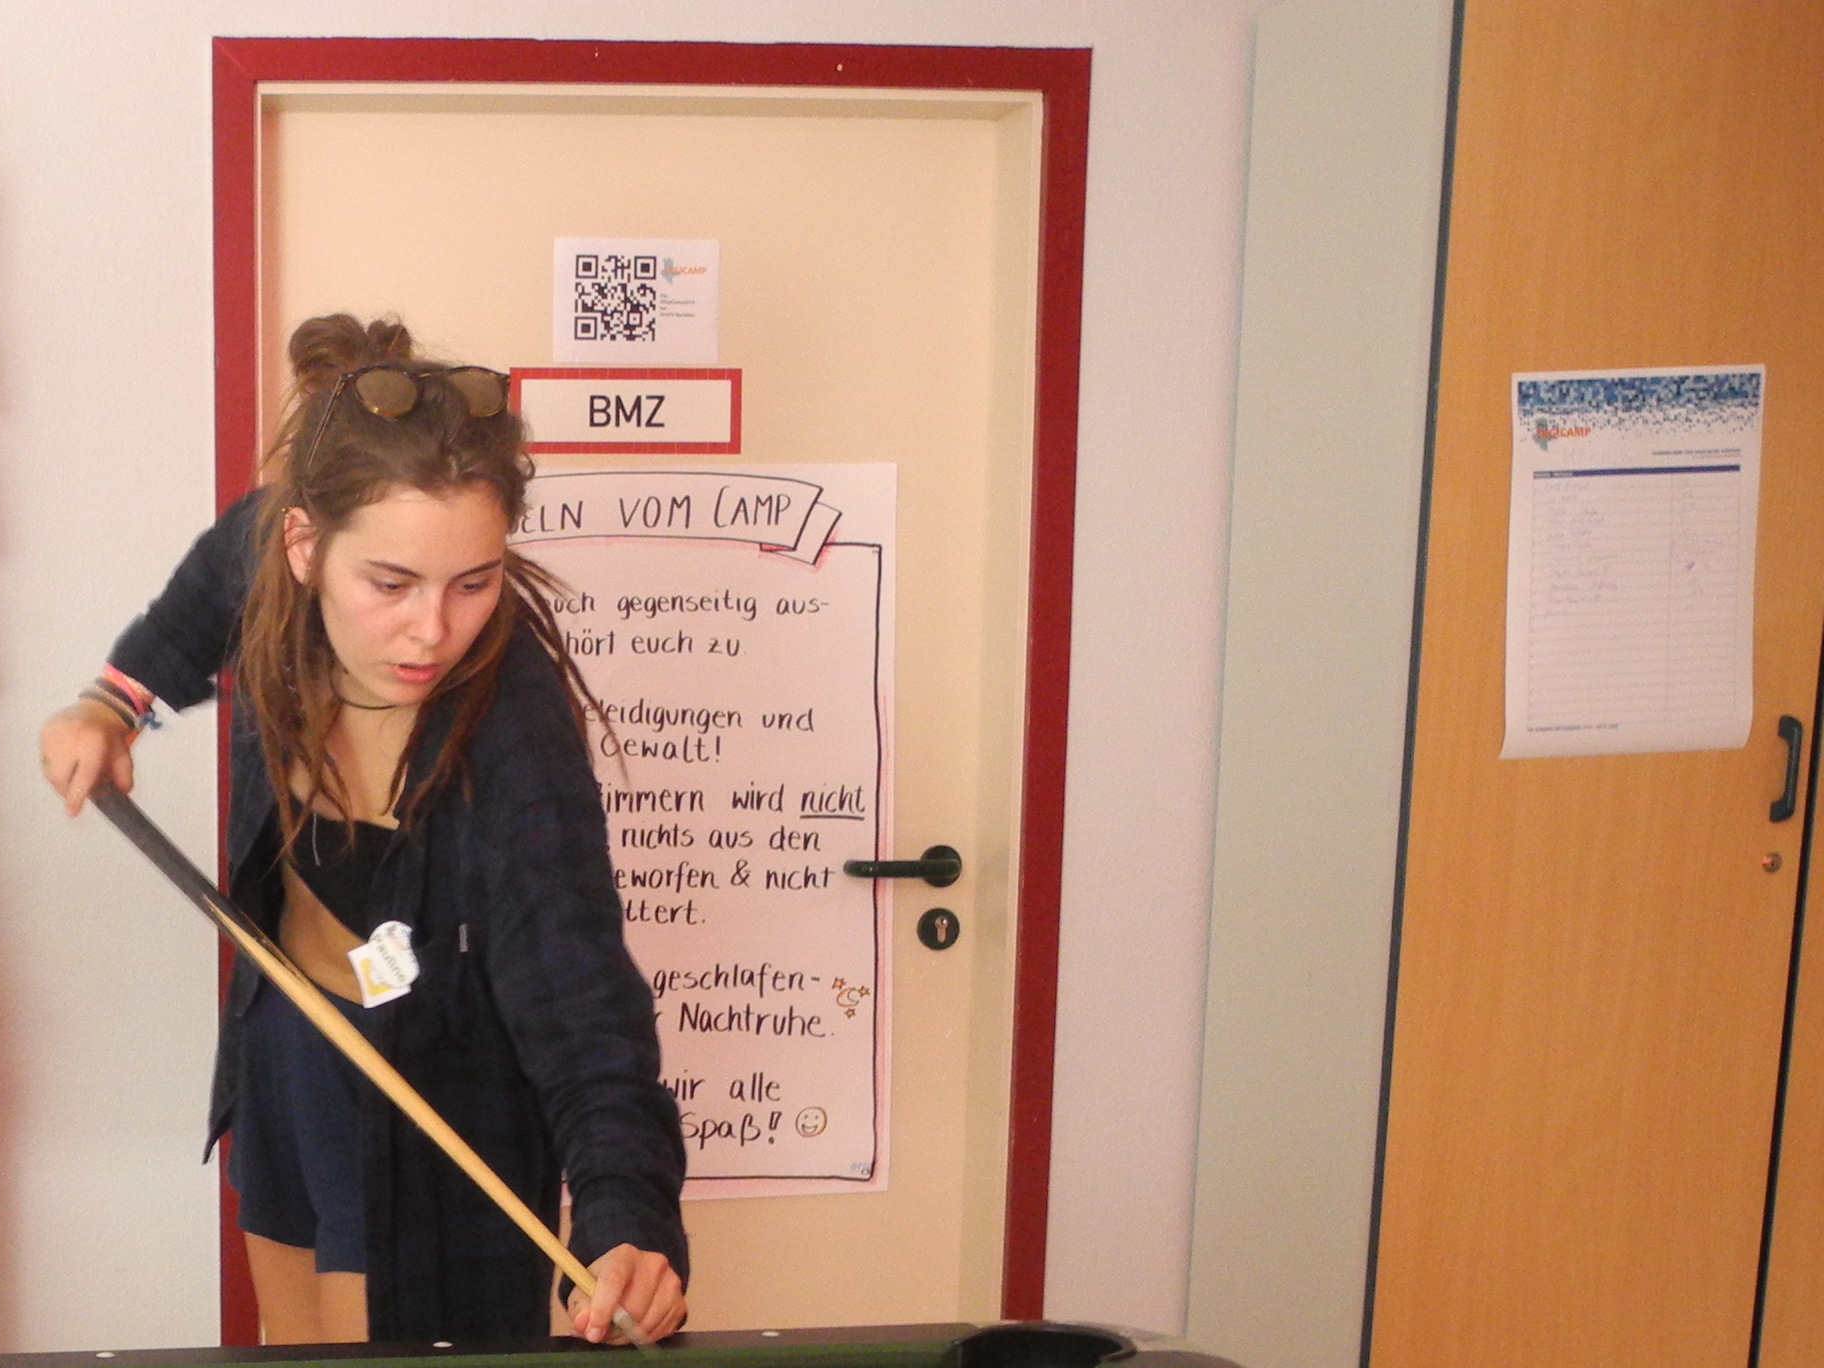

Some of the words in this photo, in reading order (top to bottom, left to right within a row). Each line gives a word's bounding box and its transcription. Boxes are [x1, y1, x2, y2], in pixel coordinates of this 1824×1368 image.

[588, 395, 666, 428] BMZ
[1537, 427, 1592, 439] DIGICAMP
[619, 494, 692, 530] VOM
[713, 485, 792, 529] CAMP
[616, 589, 758, 622] gegenseitig
[775, 597, 830, 616] aus-
[565, 628, 616, 657] hört
[630, 630, 694, 654] euch
[582, 698, 743, 735] eleidigungen
[761, 707, 815, 733] und
[731, 780, 785, 814] wird
[800, 782, 866, 817] nicht
[621, 822, 695, 850] nichts
[708, 829, 754, 850] aus
[768, 824, 822, 852] den
[613, 860, 720, 894] eworfen
[730, 858, 751, 888] &
[764, 865, 837, 890] nicht
[678, 1002, 836, 1038] Nachtruhe.
[728, 1071, 783, 1104] alle
